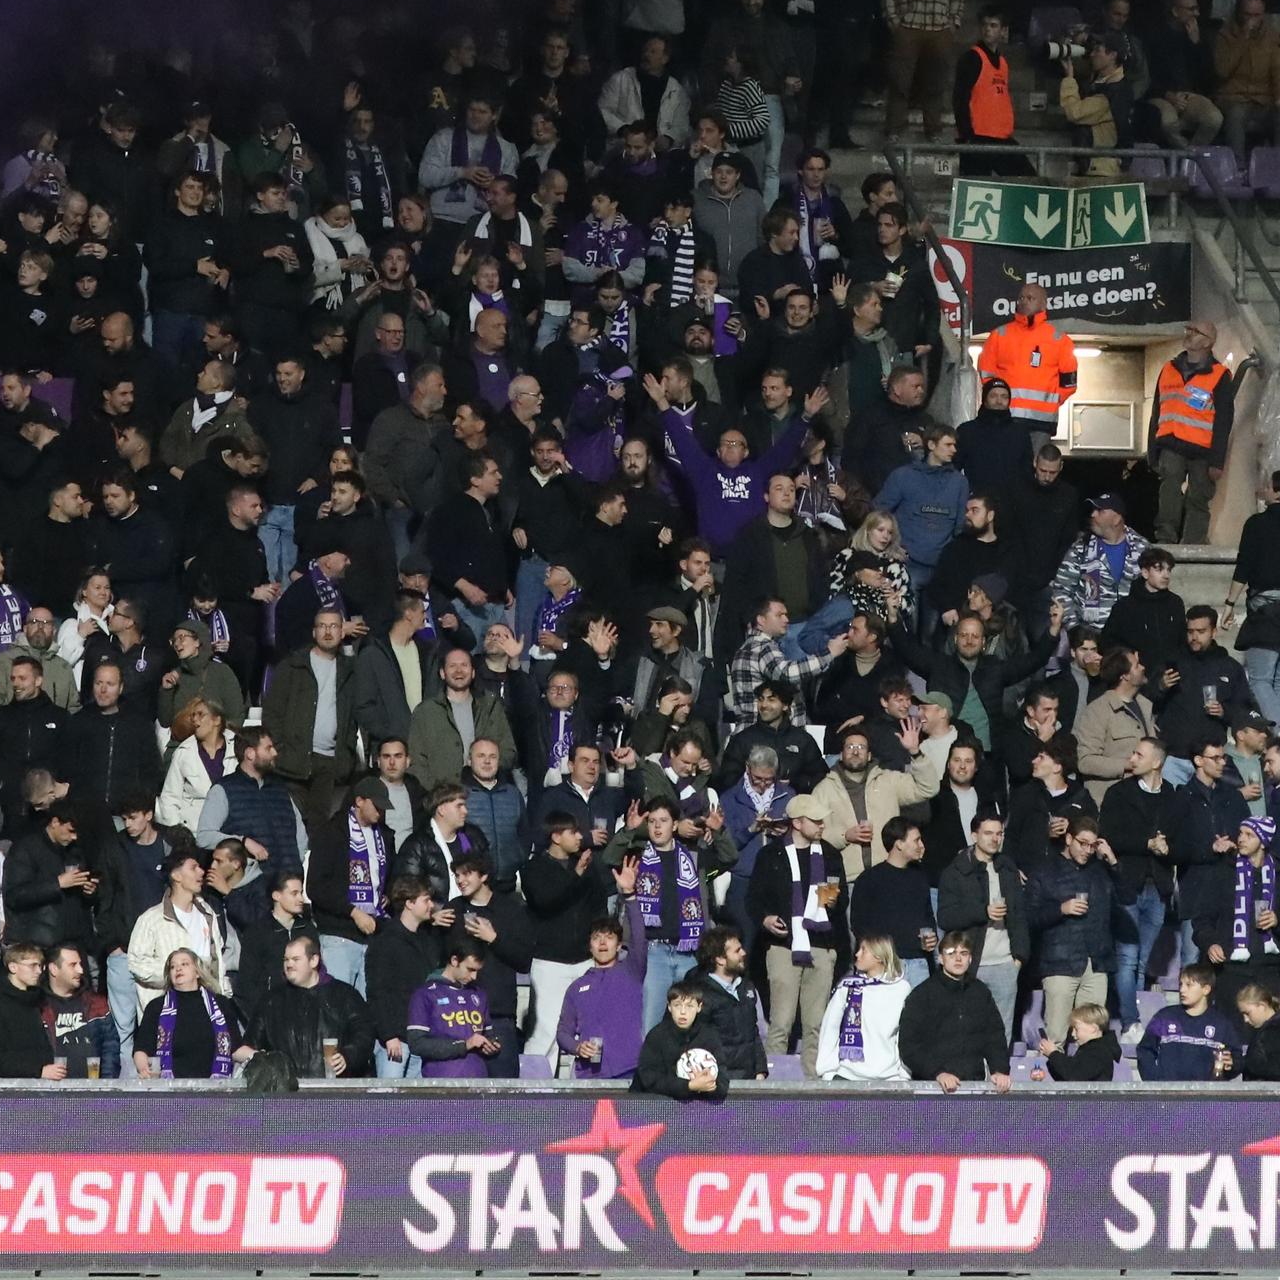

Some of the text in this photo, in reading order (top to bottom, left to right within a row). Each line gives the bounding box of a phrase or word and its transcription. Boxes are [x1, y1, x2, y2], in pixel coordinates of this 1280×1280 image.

[1026, 266, 1124, 288] En nu een
[993, 282, 1157, 316] Qukske doen?
[356, 891, 367, 901] 13
[640, 902, 652, 913] 13
[689, 927, 700, 937] 13
[441, 1010, 482, 1027] YELO
[845, 1033, 855, 1044] 13
[266, 1181, 328, 1225] TV
[403, 1148, 1031, 1252] STAR CASINO TV
